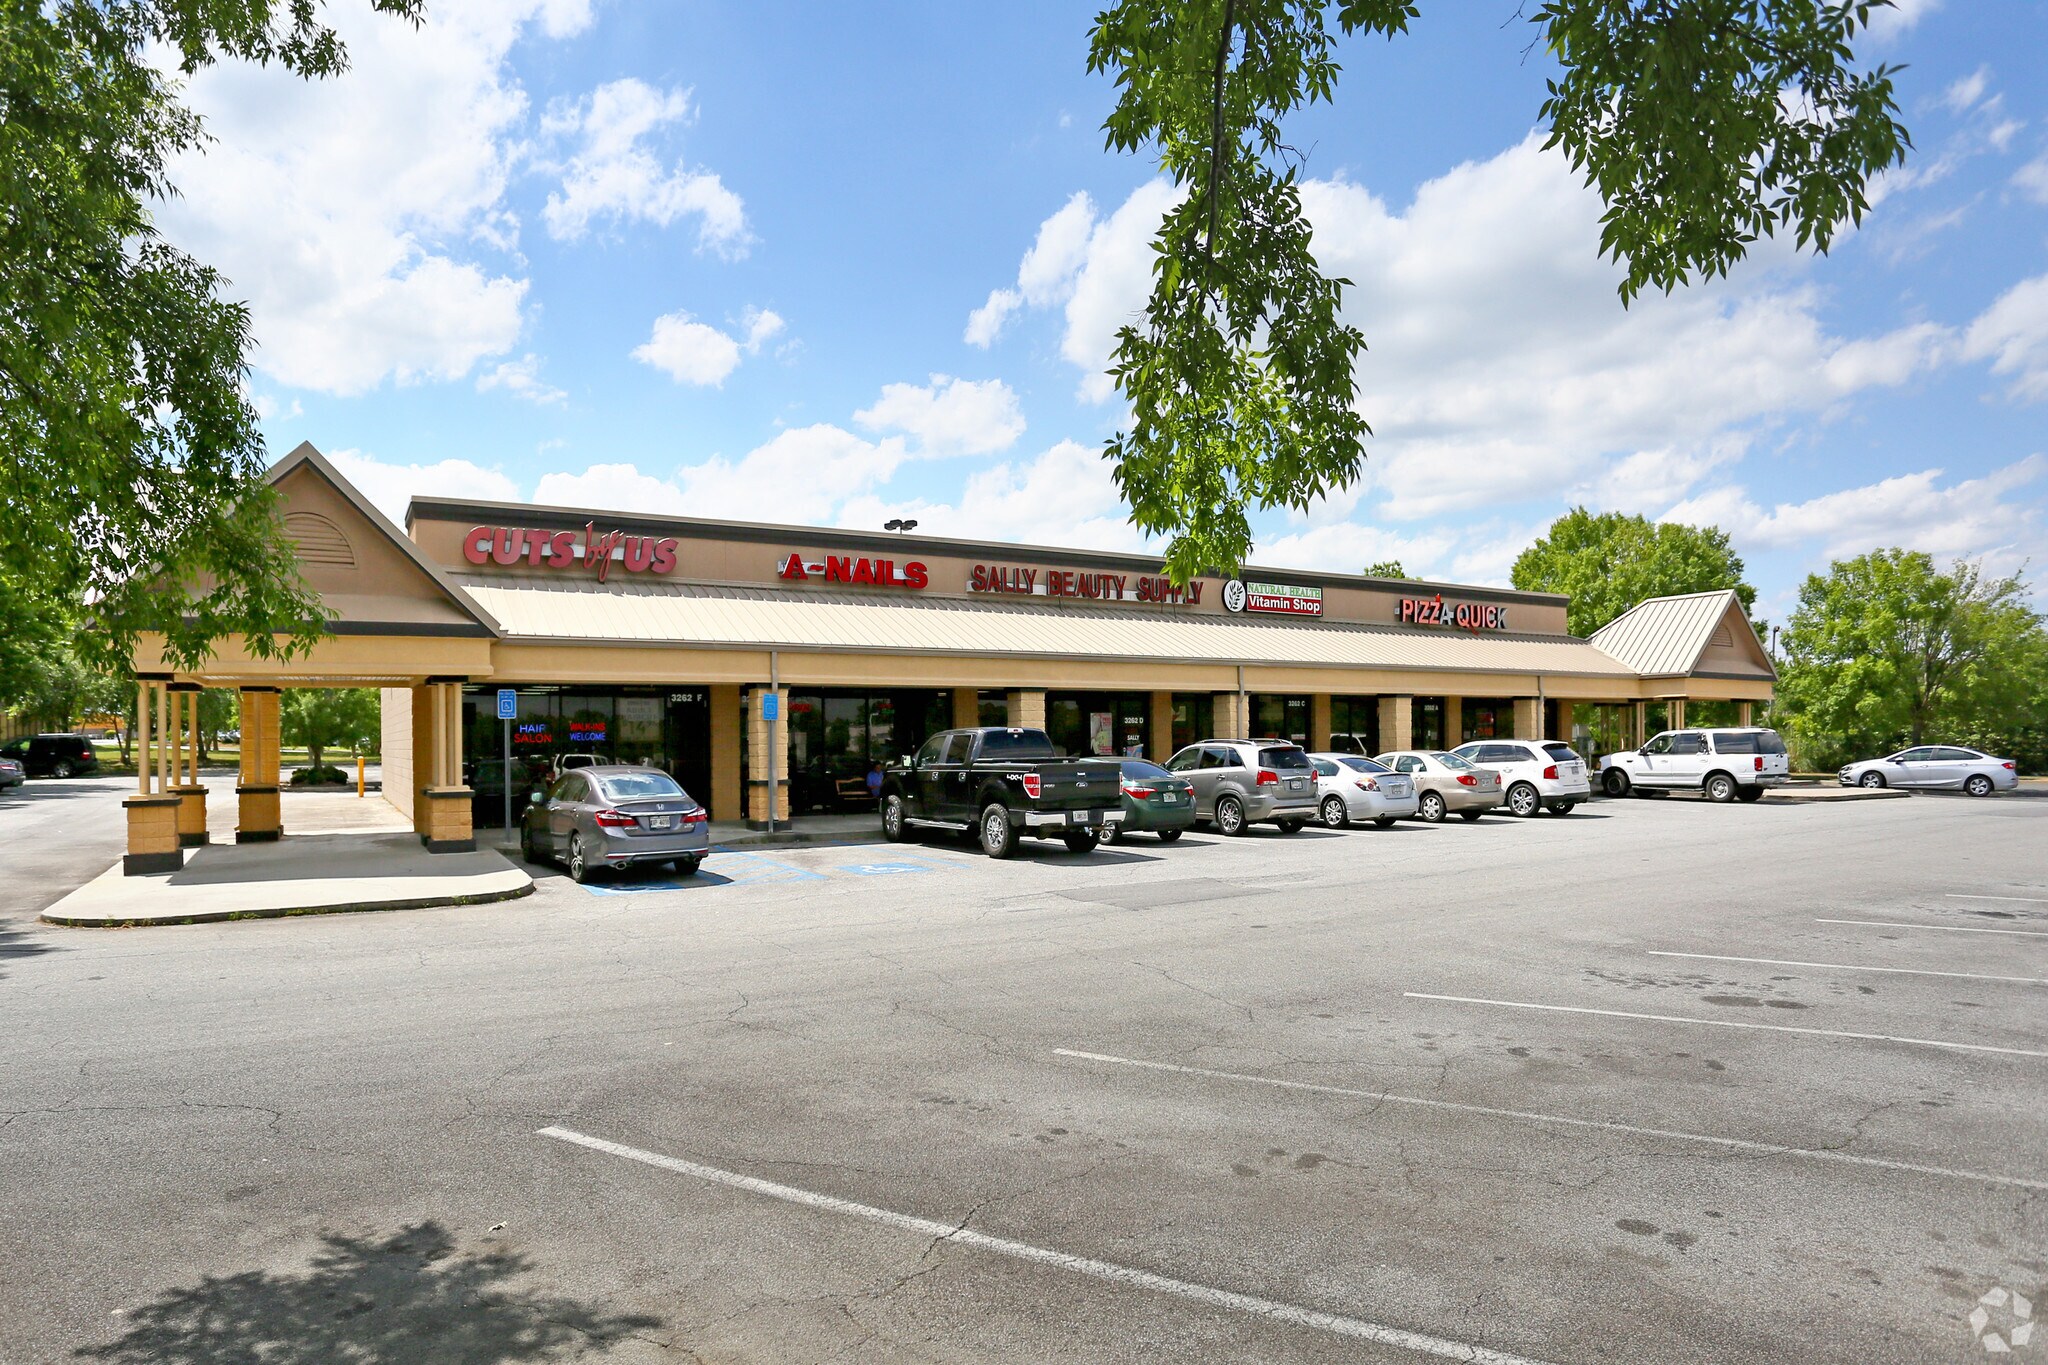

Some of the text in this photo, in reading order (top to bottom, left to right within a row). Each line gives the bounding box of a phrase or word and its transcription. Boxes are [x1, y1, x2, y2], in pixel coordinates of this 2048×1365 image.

[463, 520, 679, 583] CUTS by US
[780, 553, 929, 589] A-NAILS
[971, 564, 1038, 594] SALLY
[1046, 570, 1127, 600] BEAUTY
[1247, 583, 1322, 599] NATURAL HEALTH
[1249, 595, 1320, 613] Vitamin Shop
[1401, 599, 1509, 633] PIZZA QUICK
[671, 693, 703, 702] 3262 F
[513, 733, 553, 743] SALON
[569, 731, 606, 741] WELCOME
